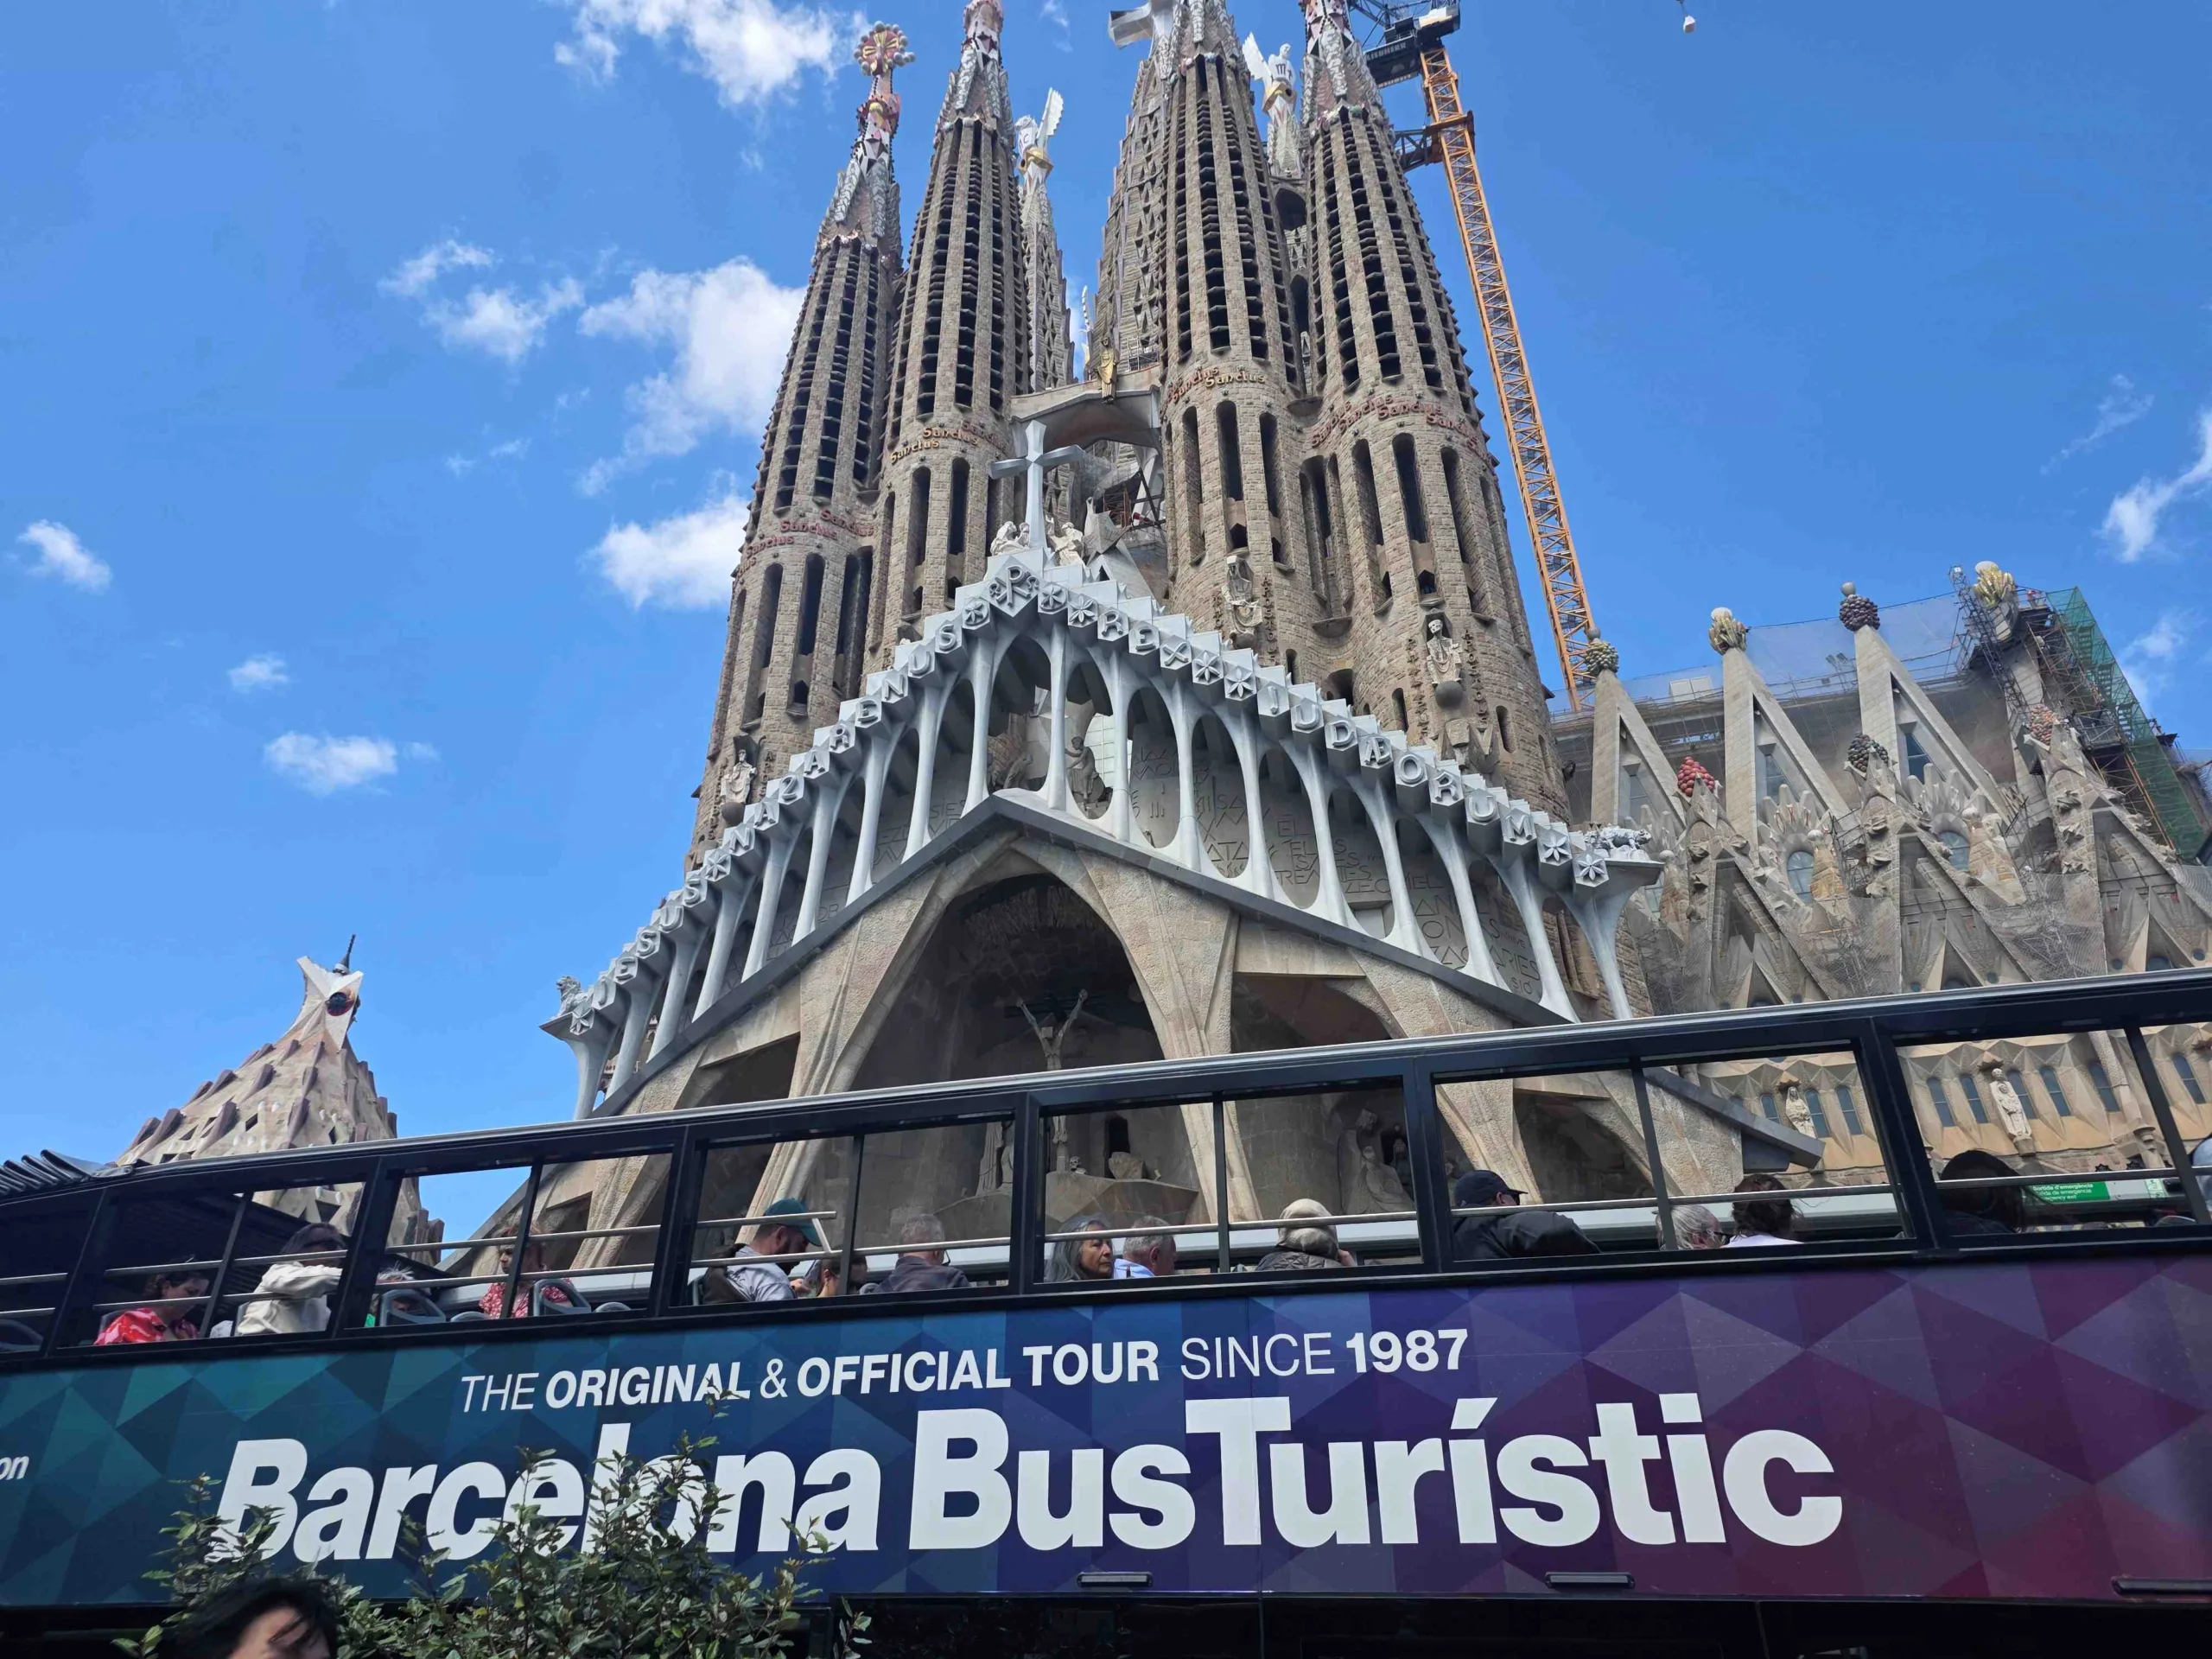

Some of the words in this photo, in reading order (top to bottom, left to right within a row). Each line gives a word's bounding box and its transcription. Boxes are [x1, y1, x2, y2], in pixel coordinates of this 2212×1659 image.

[461, 1372, 539, 1413] THE
[546, 1362, 751, 1408] ORIGINAL
[760, 1358, 788, 1399] &
[798, 1348, 1011, 1397] OFFICIAL
[1023, 1340, 1160, 1387] TOUR
[1181, 1332, 1335, 1380] SINCE
[1346, 1329, 1468, 1373] 1987
[204, 1422, 881, 1567] Barcelona
[908, 1393, 1843, 1551] BusTurístic
